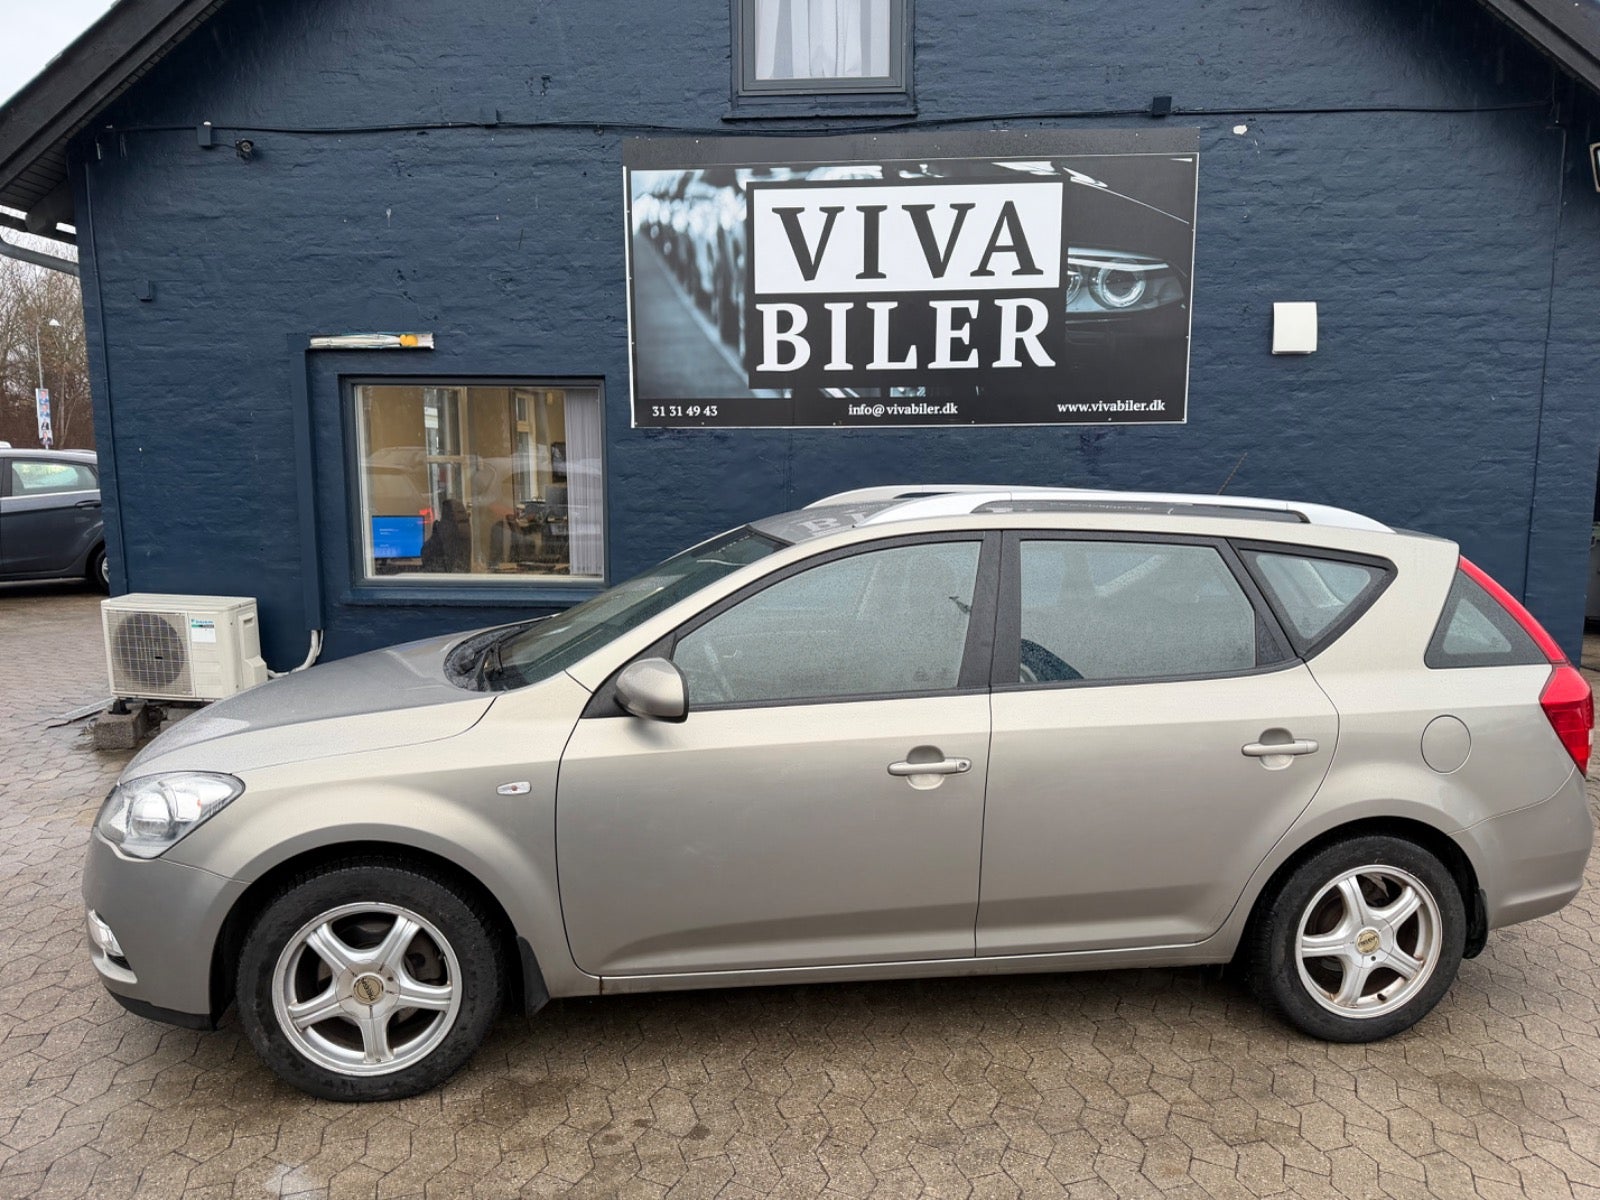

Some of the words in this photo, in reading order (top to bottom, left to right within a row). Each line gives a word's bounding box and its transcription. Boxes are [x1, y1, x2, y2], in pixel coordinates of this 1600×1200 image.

[771, 200, 1044, 282] VIVA
[755, 297, 1056, 372] BILER
[652, 405, 666, 417] 31
[669, 405, 683, 417] 31
[686, 405, 701, 417] 49
[703, 405, 718, 417] 43
[1057, 399, 1166, 413] www.vivabiler.dk
